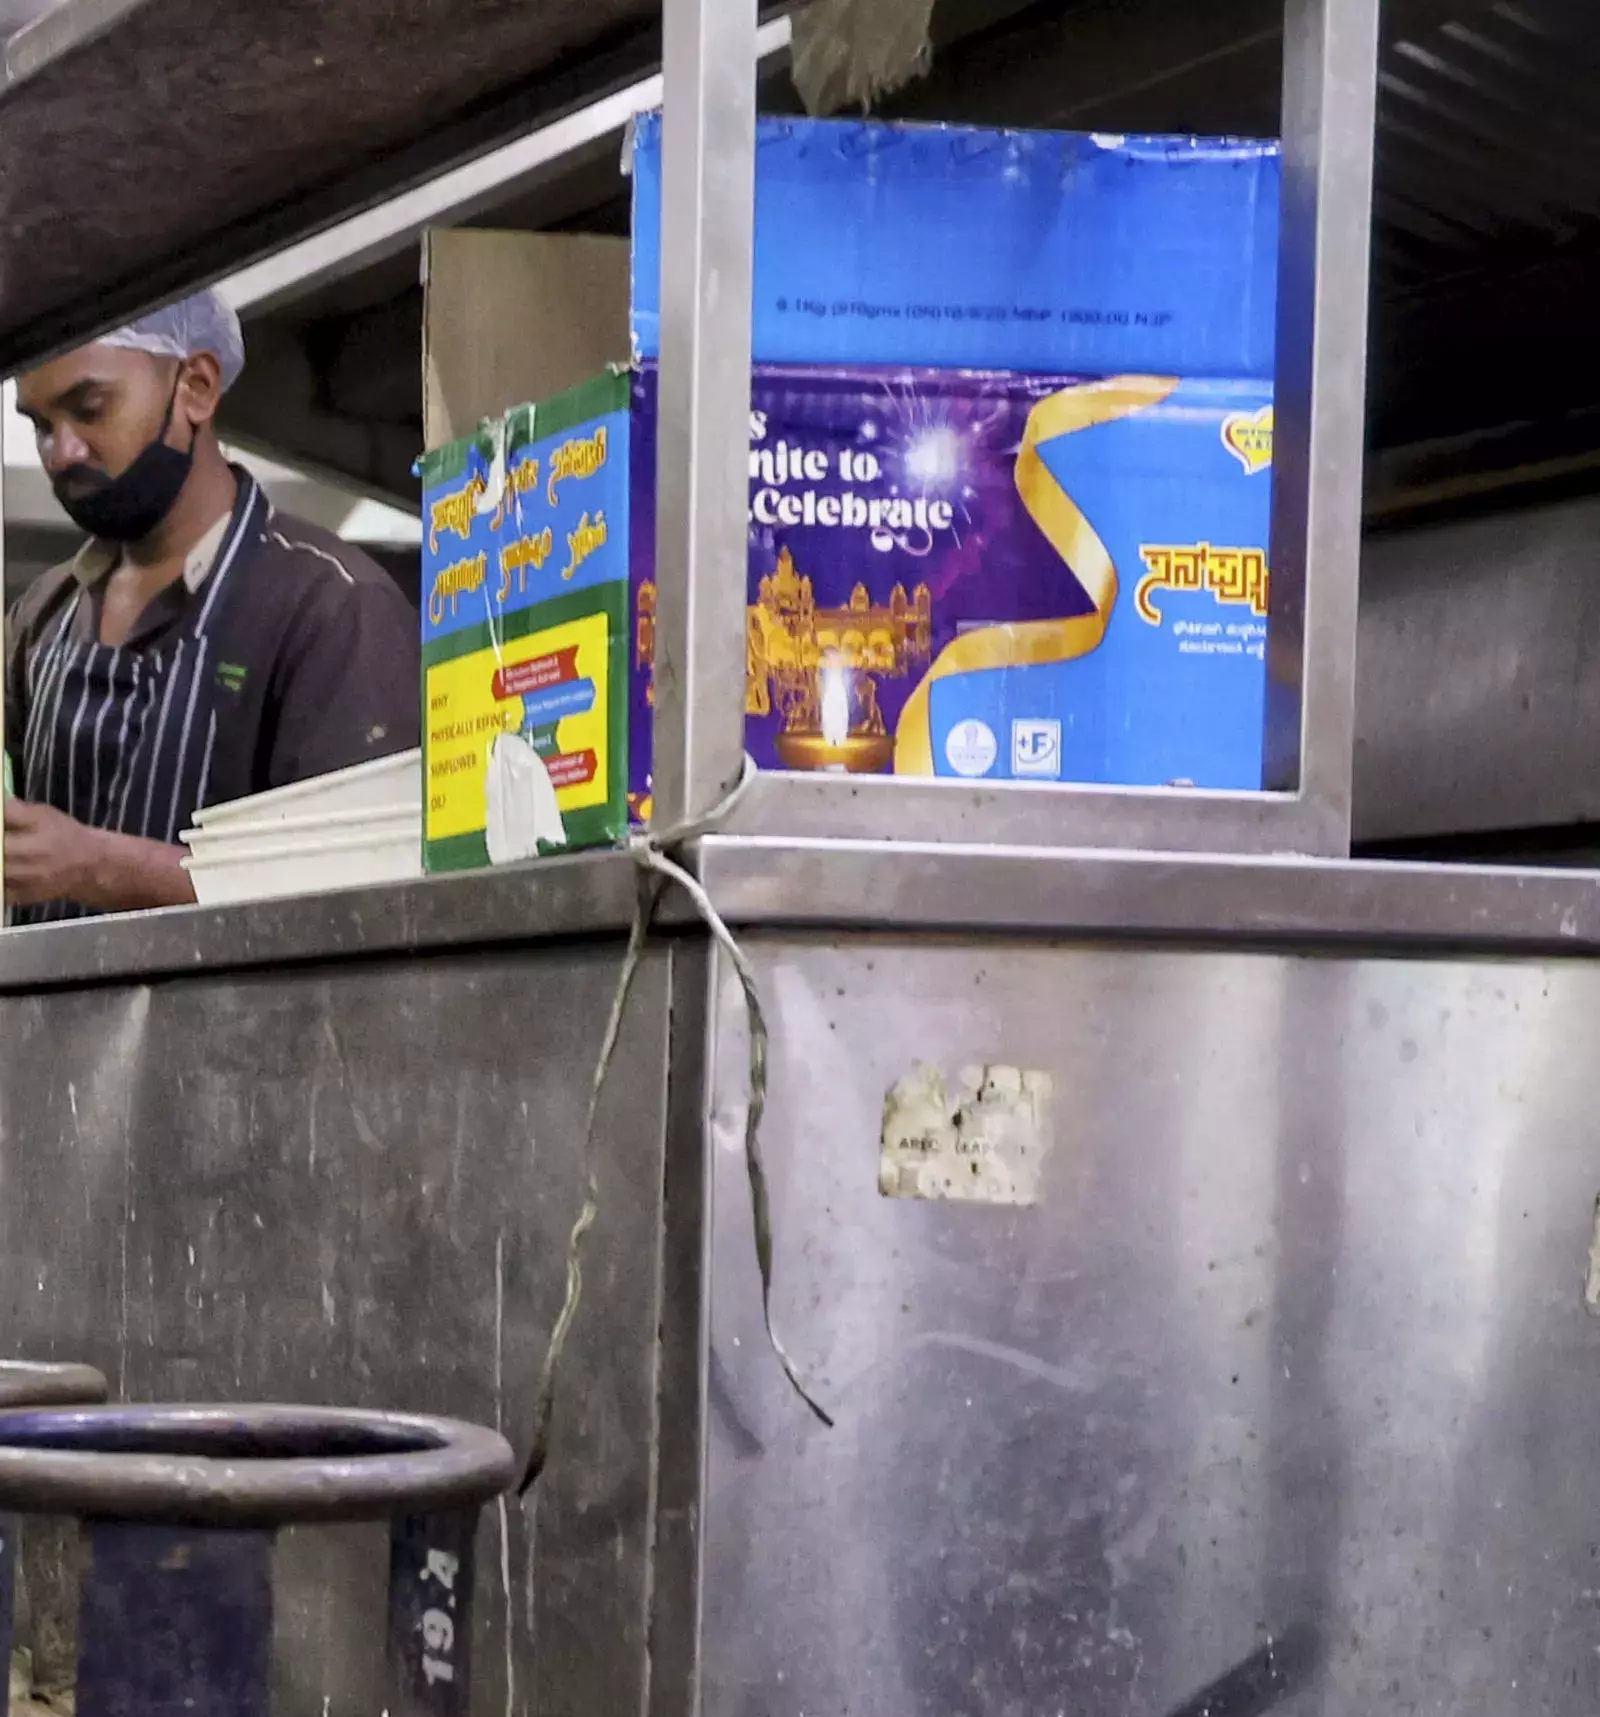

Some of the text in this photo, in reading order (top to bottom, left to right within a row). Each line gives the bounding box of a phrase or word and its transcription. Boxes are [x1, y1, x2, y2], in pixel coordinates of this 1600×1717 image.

[748, 439, 878, 486] nite to
[753, 487, 953, 556] Celebrate
